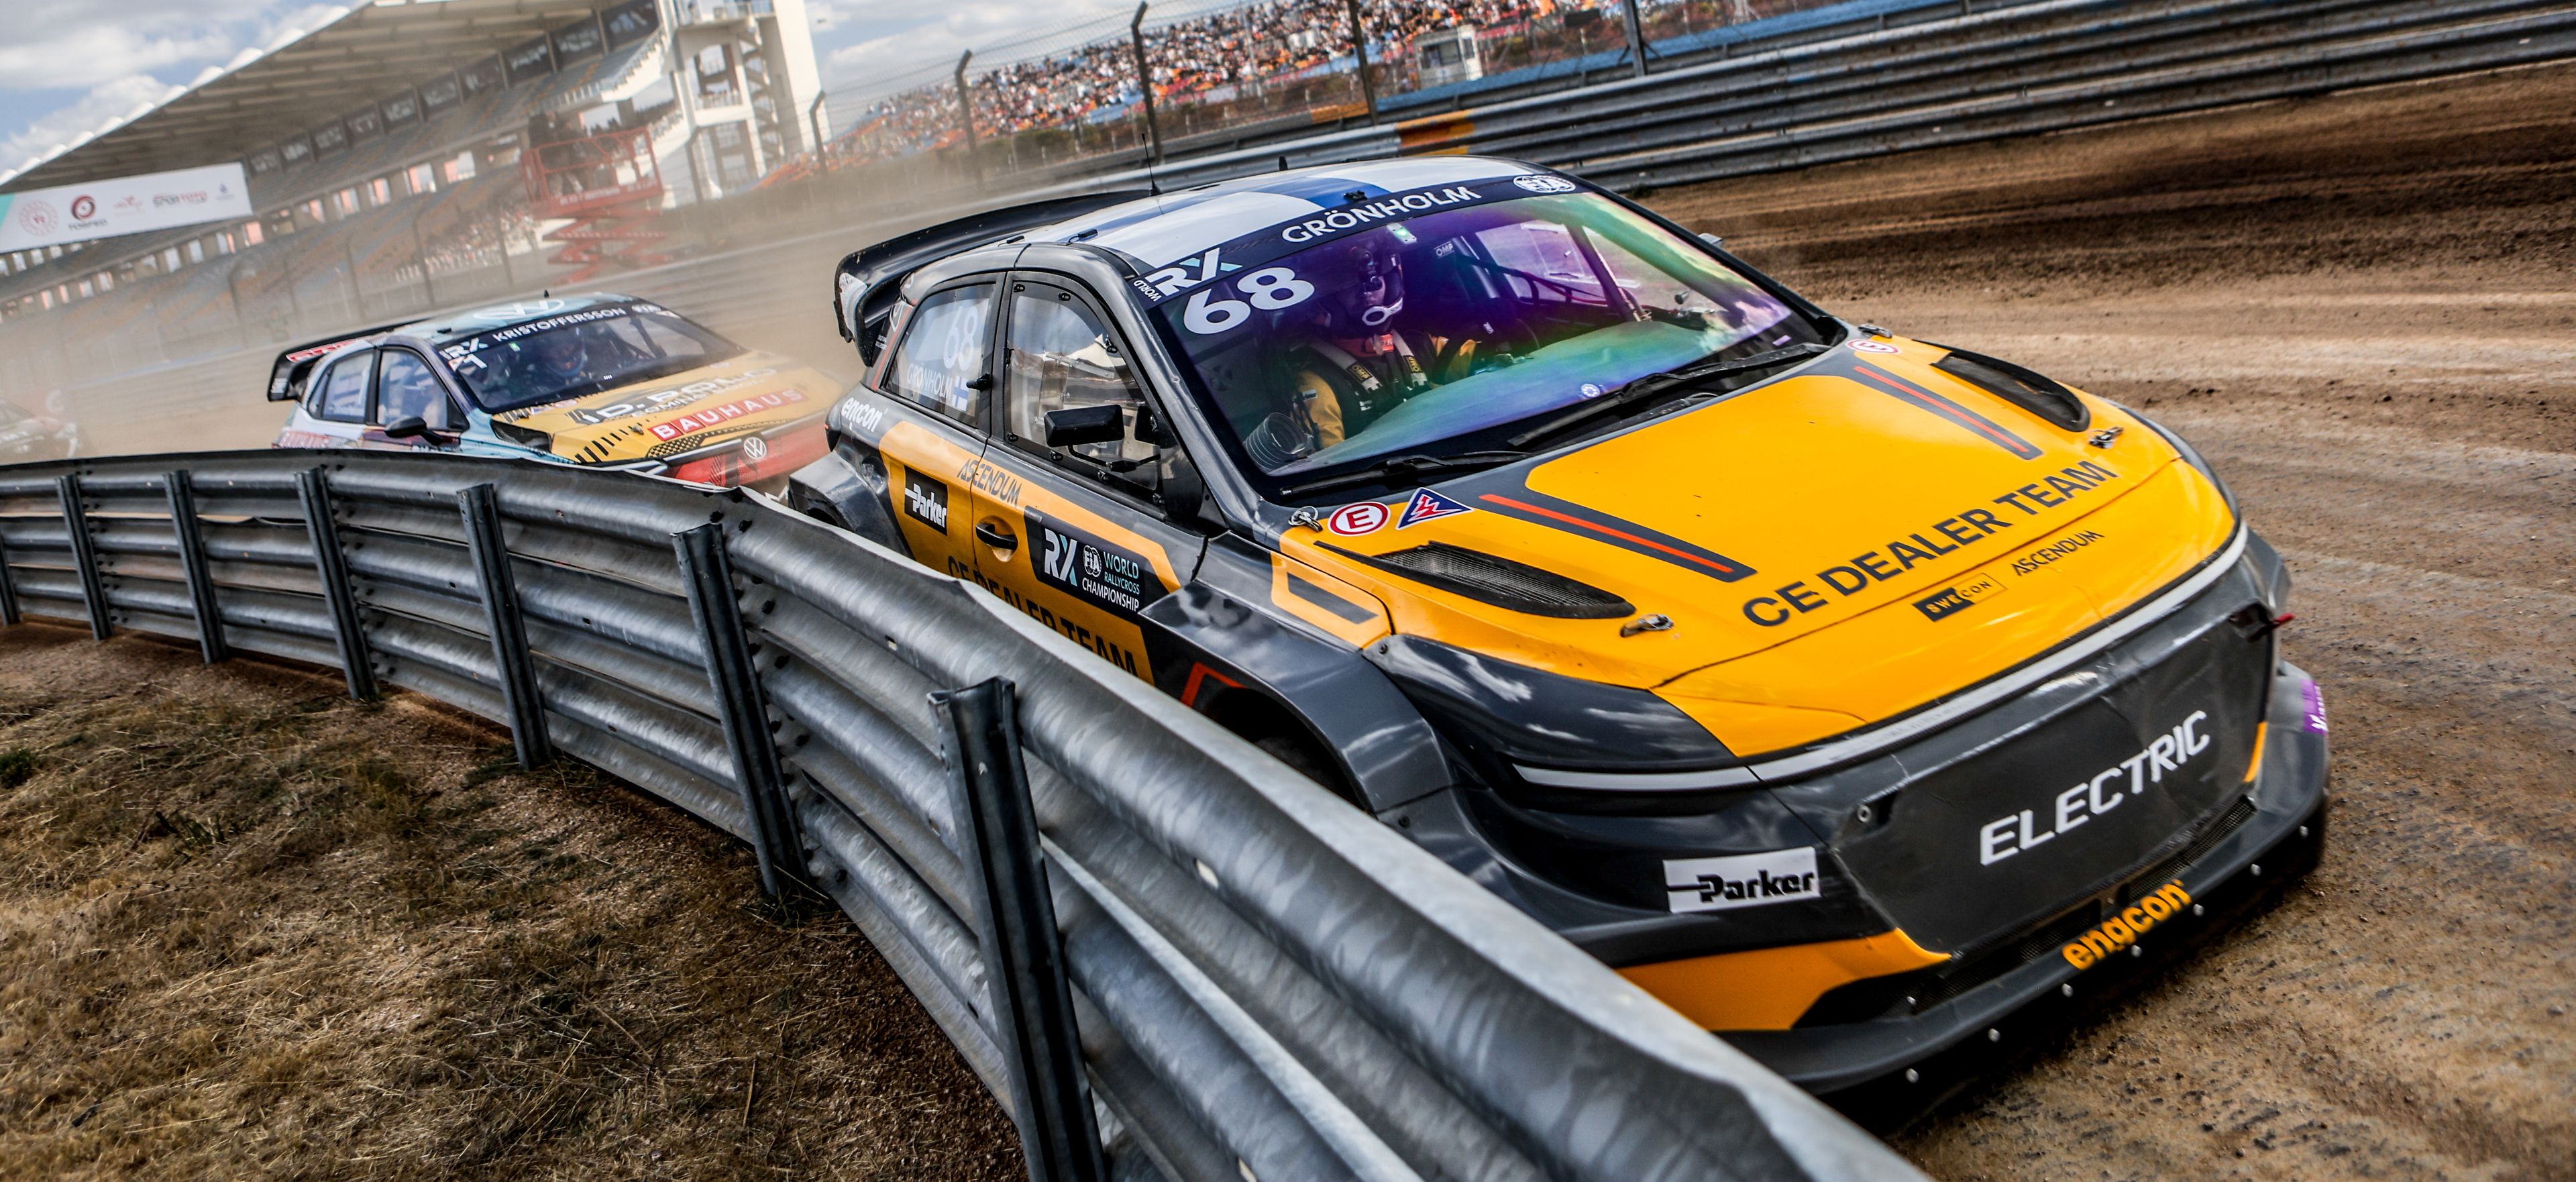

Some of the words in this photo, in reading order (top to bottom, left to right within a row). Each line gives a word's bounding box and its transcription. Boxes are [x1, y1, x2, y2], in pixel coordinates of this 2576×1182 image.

[1282, 186, 1482, 243] GRÖNHOLM
[1133, 279, 1163, 302] WORLD
[1144, 247, 1242, 297] RX
[1183, 267, 1315, 334] 68
[492, 307, 627, 342] KRISTOFFERSSON
[943, 306, 979, 372] 68
[907, 362, 954, 399] GRÖNHOLM
[655, 390, 804, 440] BAUHAUS
[910, 483, 948, 528] Parker
[957, 459, 1022, 506] ASCENDUM
[1044, 528, 1078, 586] RX
[1083, 547, 1102, 576] FIA
[1104, 551, 1140, 579] WORLD
[1744, 581, 1829, 627] CE
[1817, 508, 2013, 597] DEALER
[1993, 460, 2118, 515] TEAM
[2012, 530, 2105, 577] ASCENDUM
[1082, 577, 1140, 612] CHAMPIONSHIP
[1104, 572, 1140, 595] RALLYCROSS
[1925, 580, 1992, 613] SWECON
[1979, 710, 2210, 867] ELECTRIC
[1690, 869, 1815, 903] Parker
[2061, 878, 2192, 970] engcon
